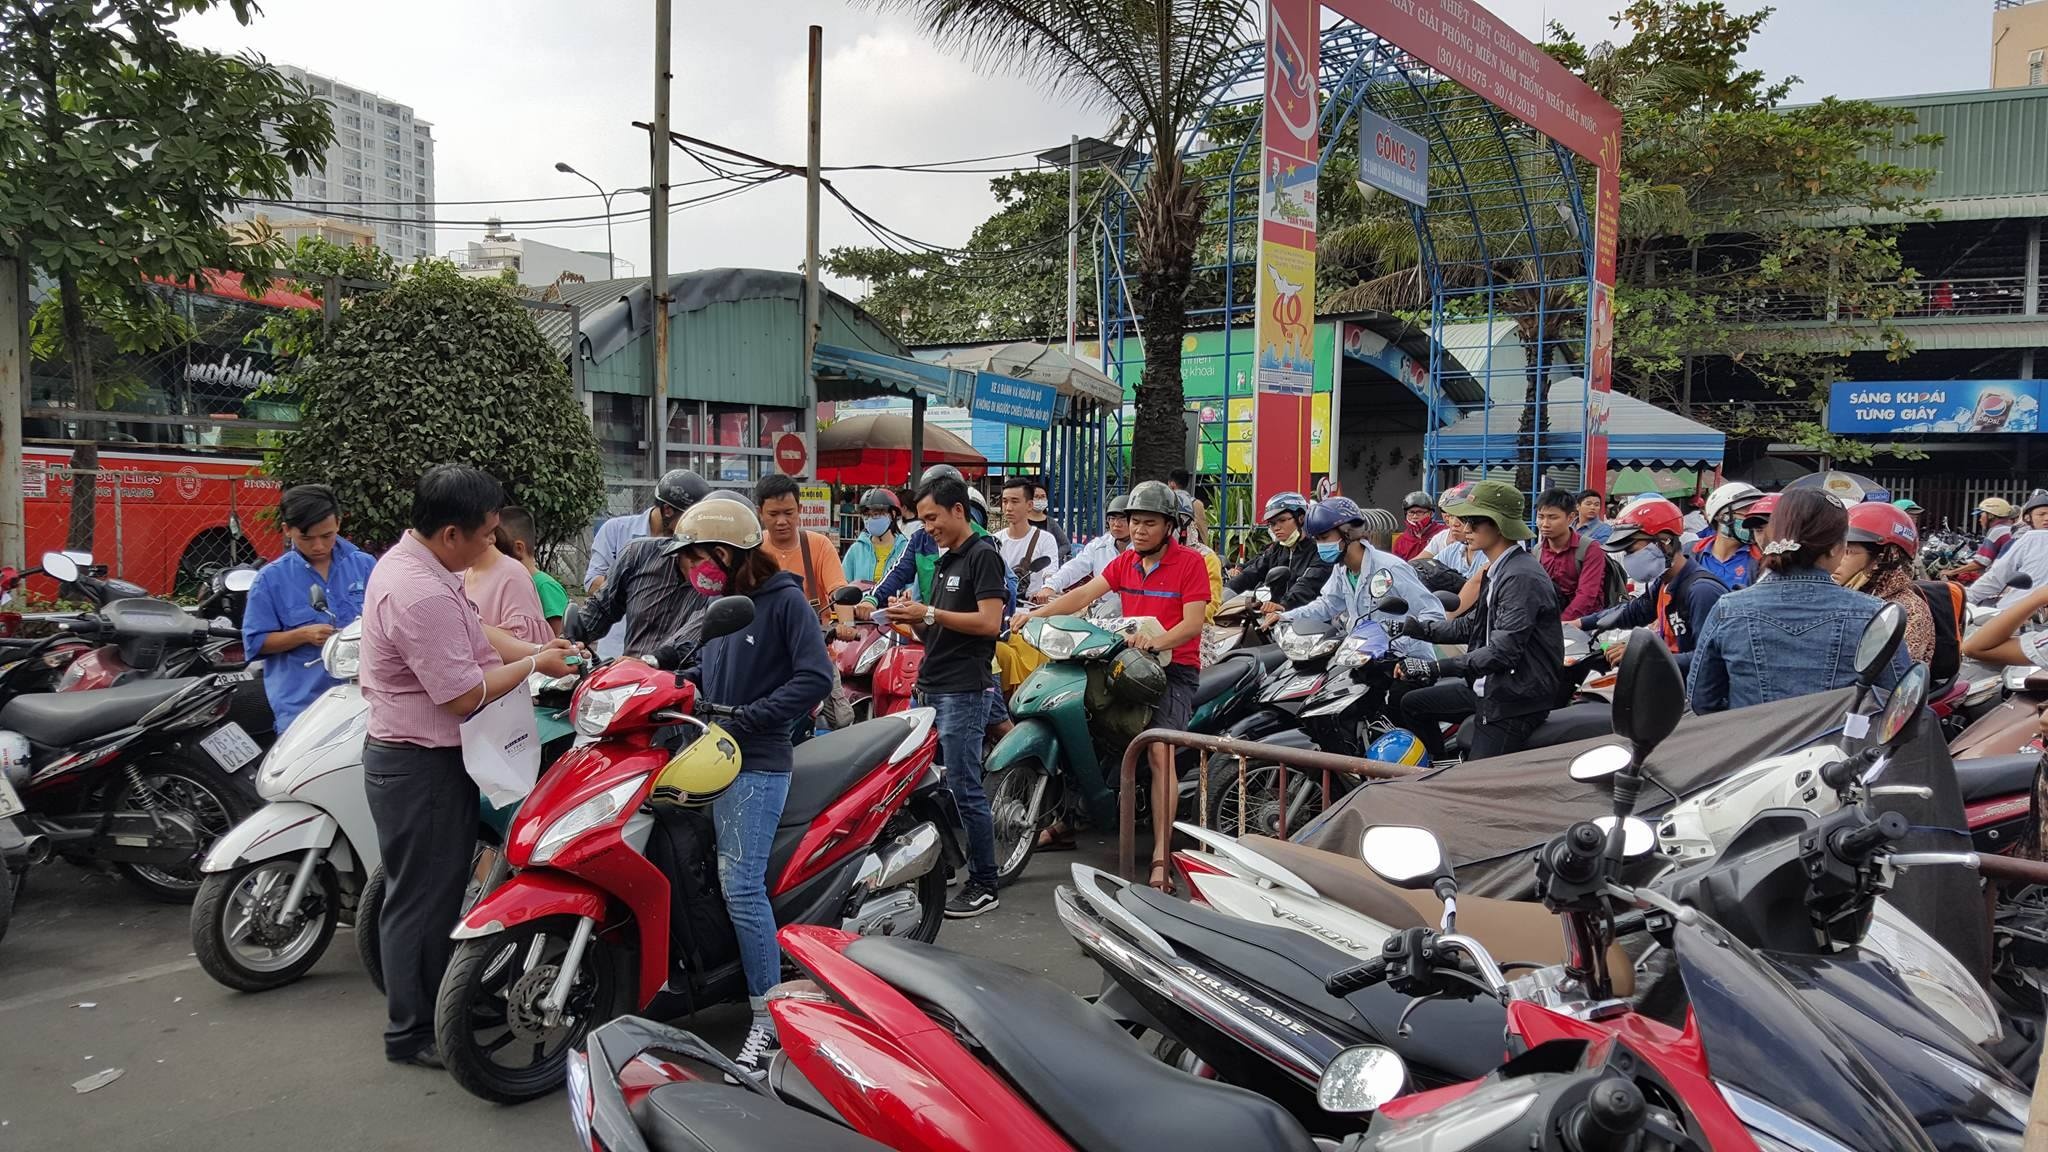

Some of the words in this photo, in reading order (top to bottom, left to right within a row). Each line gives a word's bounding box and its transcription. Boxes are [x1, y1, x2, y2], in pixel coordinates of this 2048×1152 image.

[1417, 8, 1440, 32] GIẢI
[1441, 20, 1473, 53] PHÓNG
[1475, 43, 1498, 69] MIỀN
[1500, 59, 1517, 82] NAM
[1519, 71, 1545, 100] THỐNG
[1545, 90, 1565, 113] NHẤT
[1566, 103, 1580, 123] ĐẤT
[1472, 13, 1493, 40] LIỆT
[1494, 25, 1517, 56] CHÀO
[1518, 48, 1541, 73] MỪNG
[1437, 46, 1487, 88] (30/4/1975
[1494, 81, 1537, 121] 30/4/2015)
[1408, 148, 1417, 174] 2
[1258, 895, 1369, 950] VISION
[1220, 985, 1311, 1036] BLADE
